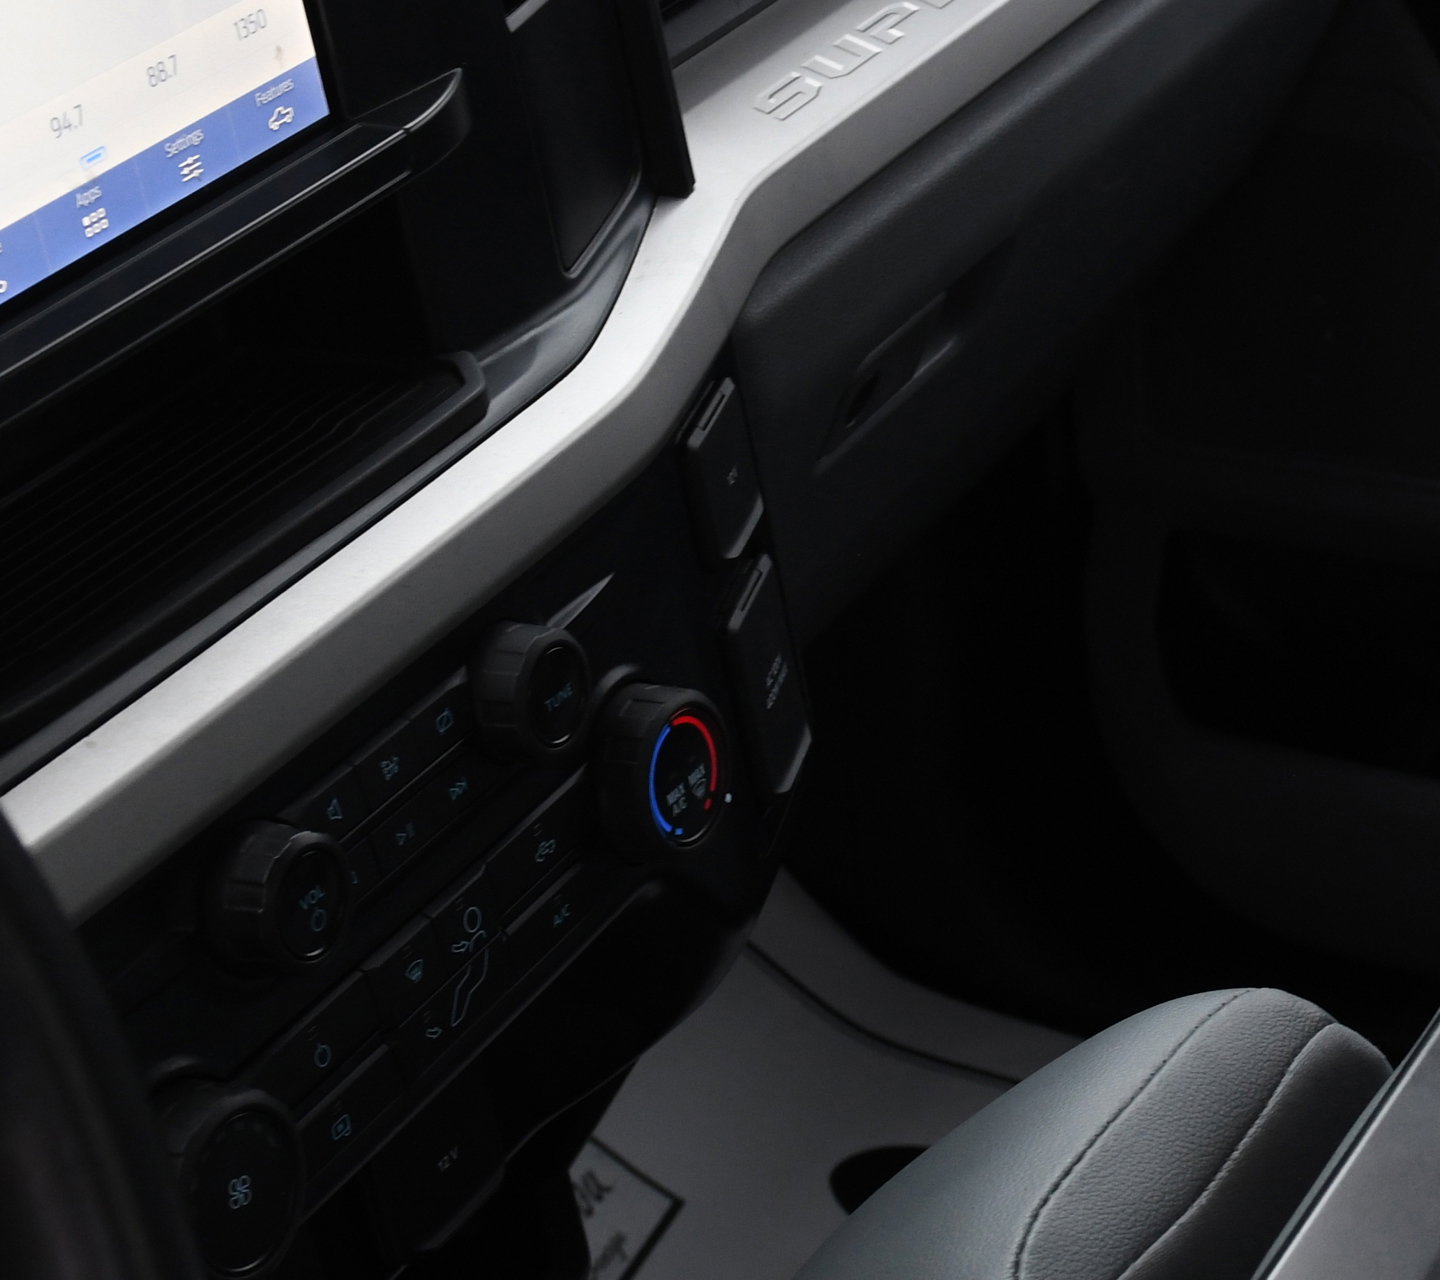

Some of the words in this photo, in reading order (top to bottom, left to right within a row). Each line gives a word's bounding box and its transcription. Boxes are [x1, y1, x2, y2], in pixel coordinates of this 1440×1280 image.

[232, 8, 269, 41] 1350
[145, 53, 178, 88] 88.7
[254, 77, 296, 107] Features
[49, 103, 84, 140] 94.7
[164, 127, 206, 158] Settings
[75, 184, 103, 209] Apps
[543, 680, 576, 714] TUNE
[687, 762, 708, 789] MAX
[665, 781, 687, 808] MAX
[297, 883, 327, 911] VOL
[552, 903, 573, 929] A/C
